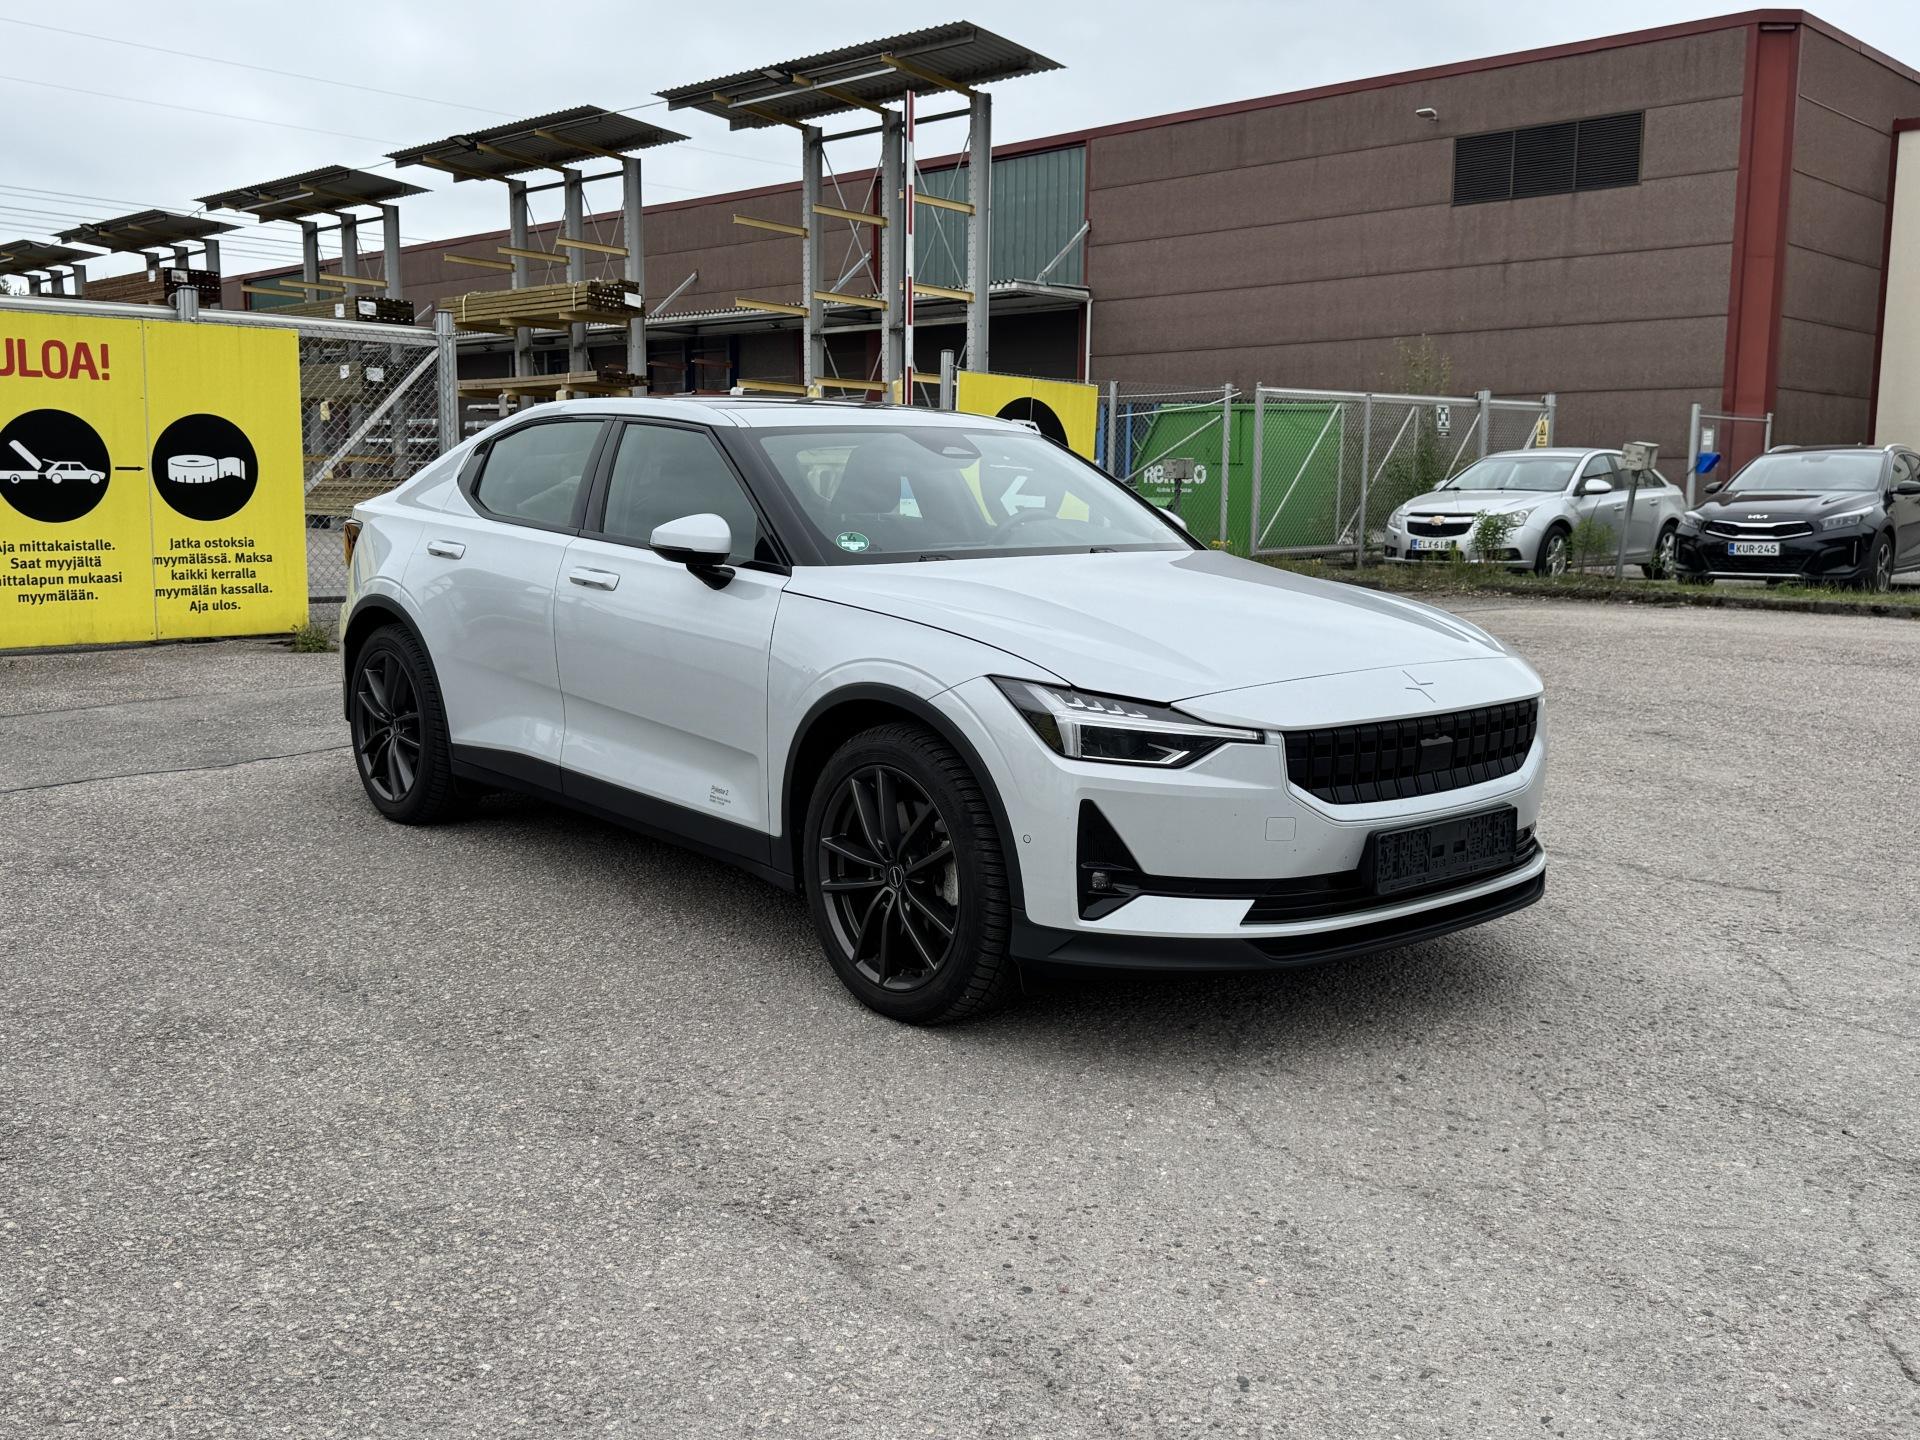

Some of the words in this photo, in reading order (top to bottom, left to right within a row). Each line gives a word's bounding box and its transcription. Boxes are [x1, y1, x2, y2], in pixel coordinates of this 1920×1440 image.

[19, 539, 116, 552] mittakaistalle.
[169, 537, 201, 550] Jatka
[204, 536, 255, 549] ostoksia
[1736, 544, 1777, 554] KUR-245
[10, 557, 42, 569] Saat
[45, 556, 102, 571] myyjältä
[152, 553, 232, 567] myymälässä.
[234, 552, 273, 563] Maksa
[0, 574, 64, 588] ittalapun
[68, 571, 123, 584] mukaasi
[171, 569, 208, 580] kaikki
[211, 567, 257, 579] kerralla
[18, 589, 99, 605] myymälään.
[155, 584, 217, 599] myymälän
[221, 582, 273, 595] kassalla.
[189, 600, 209, 613] Aja
[212, 600, 242, 611] ulos.
